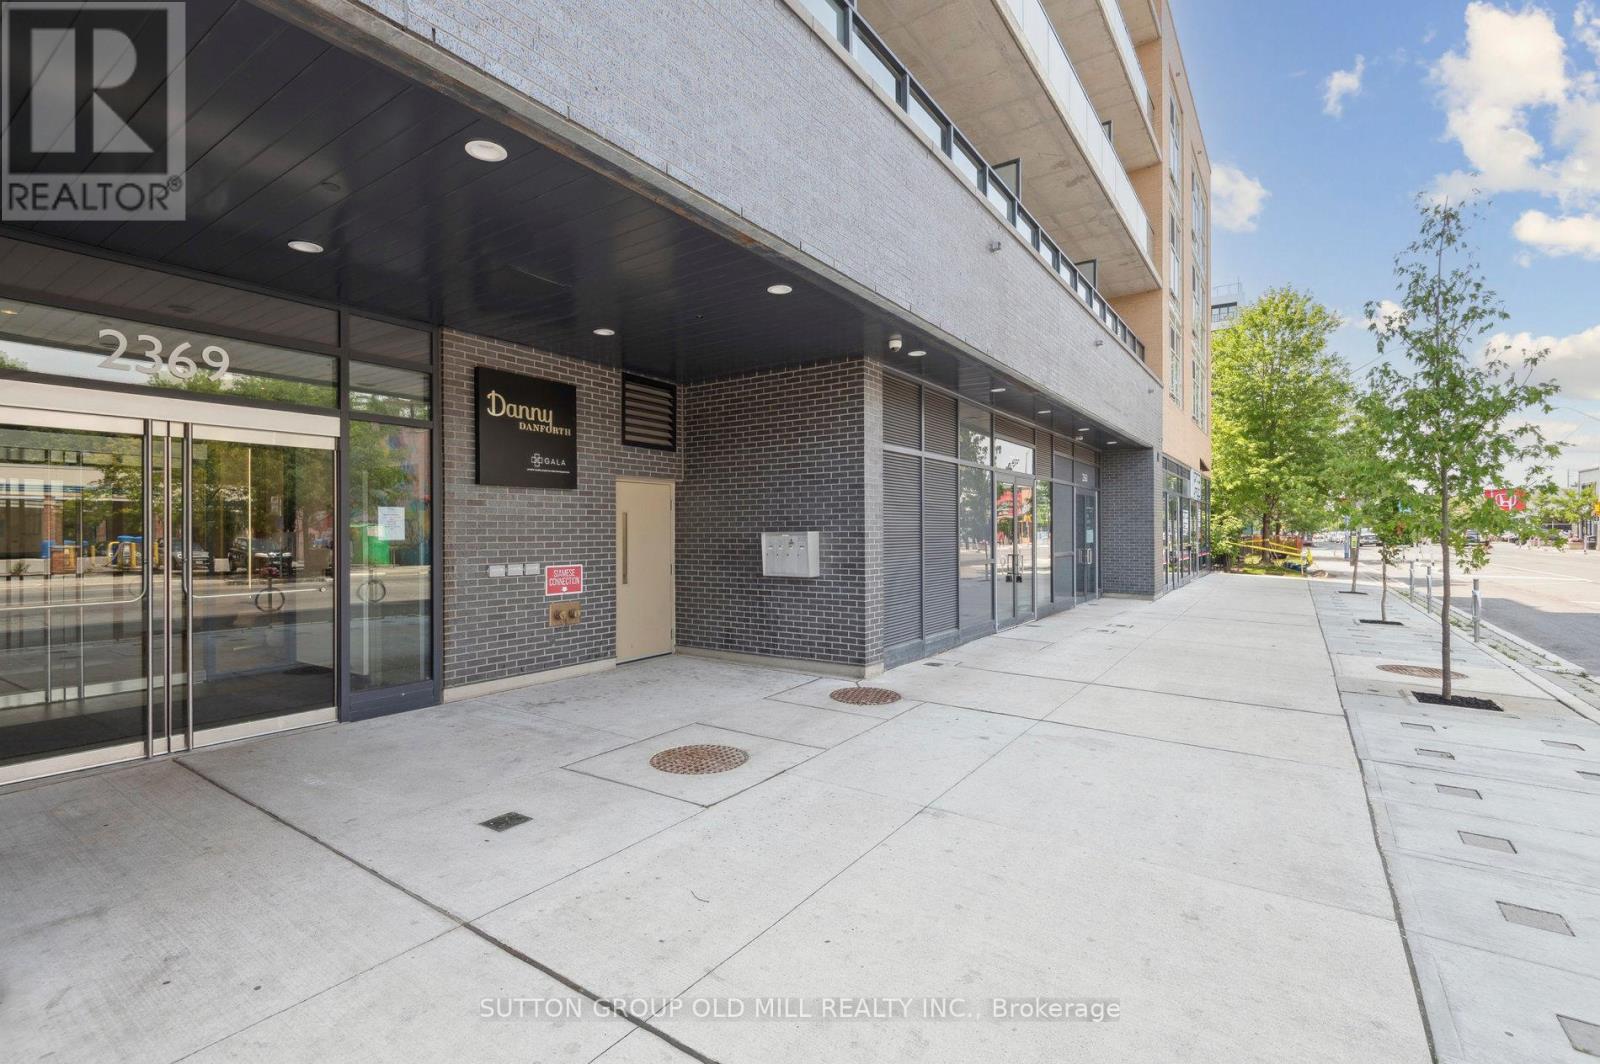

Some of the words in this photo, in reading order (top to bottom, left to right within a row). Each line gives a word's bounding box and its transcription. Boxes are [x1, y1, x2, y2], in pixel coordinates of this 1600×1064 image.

[97, 328, 230, 381] 2369
[487, 389, 553, 432] Danny
[519, 421, 571, 436] DANFORTH
[544, 457, 566, 466] GALA
[549, 577, 580, 587] CONNECTION
